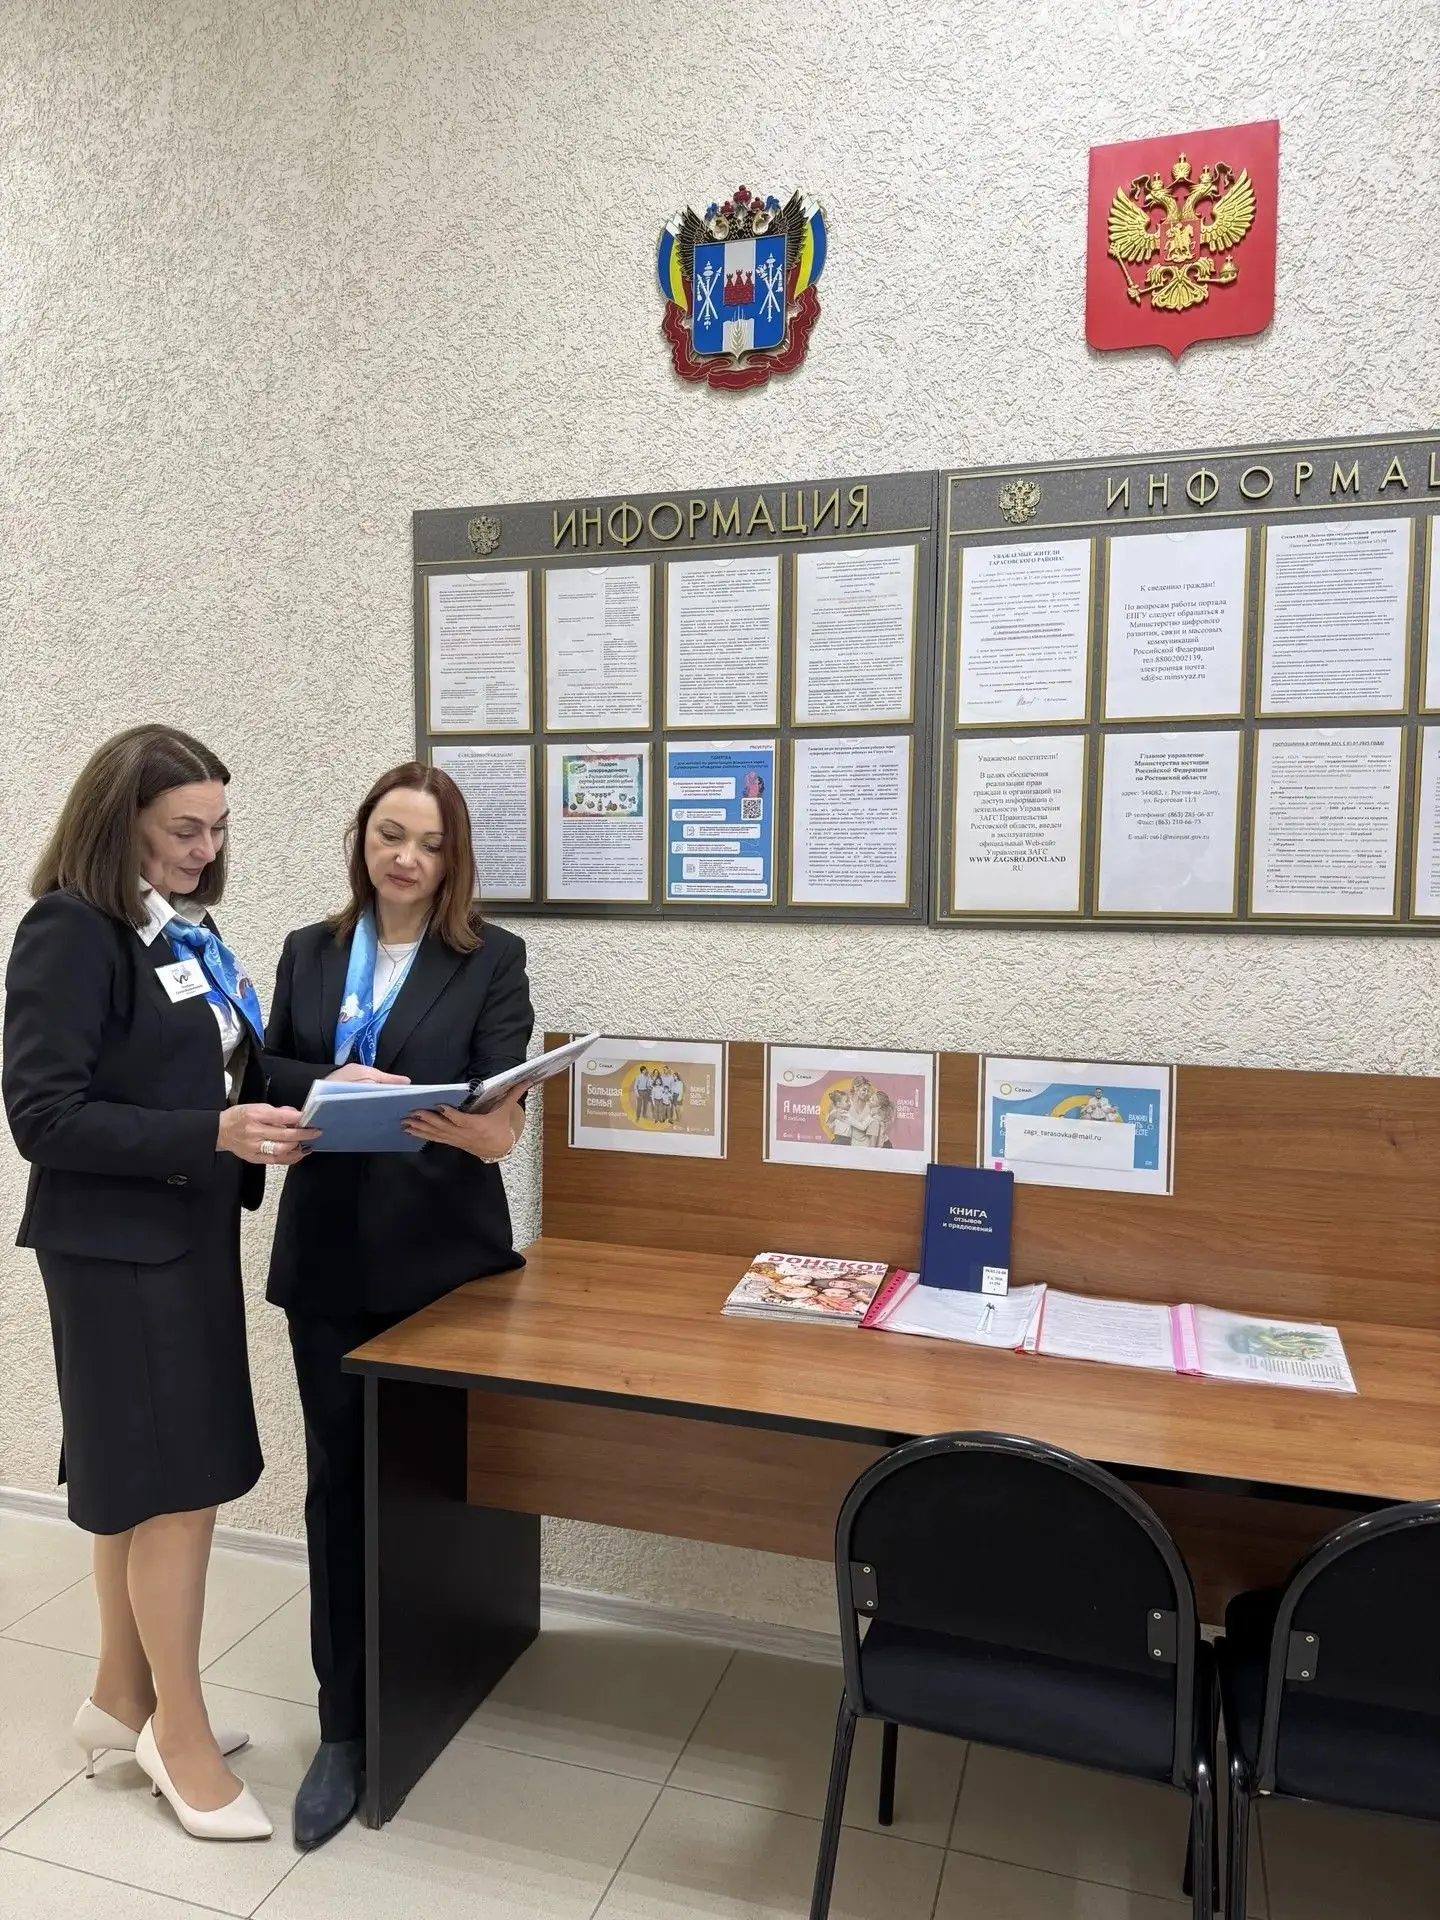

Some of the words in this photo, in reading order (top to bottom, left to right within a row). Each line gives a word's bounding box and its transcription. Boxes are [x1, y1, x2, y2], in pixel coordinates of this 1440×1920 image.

[552, 485, 870, 548] ИНФОРМАЦИЯ
[993, 551, 1032, 559] УВАЖАЕМЫЕ
[1183, 580, 1216, 590] граждан!
[1136, 603, 1169, 611] вопросам
[1172, 601, 1197, 609] работы
[1149, 611, 1175, 619] следует
[1177, 609, 1219, 617] обращаться
[1130, 620, 1181, 630] Министерство
[1182, 618, 1220, 626] цифрового
[1126, 630, 1160, 639] развития,
[1147, 636, 1199, 645] коммуникаций
[1133, 647, 1174, 655] Российской
[1140, 665, 1182, 674] электронная
[1018, 753, 1059, 761] посетители!
[1008, 788, 1051, 796] организаций
[587, 1084, 623, 1097] Большая
[587, 1099, 612, 1108] семья
[784, 1101, 790, 1113] Я
[792, 1104, 820, 1115] мама
[1024, 1128, 1102, 1141] zags_tarasovka@mail.ru
[950, 1207, 987, 1218] КНИГА
[954, 1217, 982, 1225] отзывов
[948, 1223, 993, 1233] предложений
